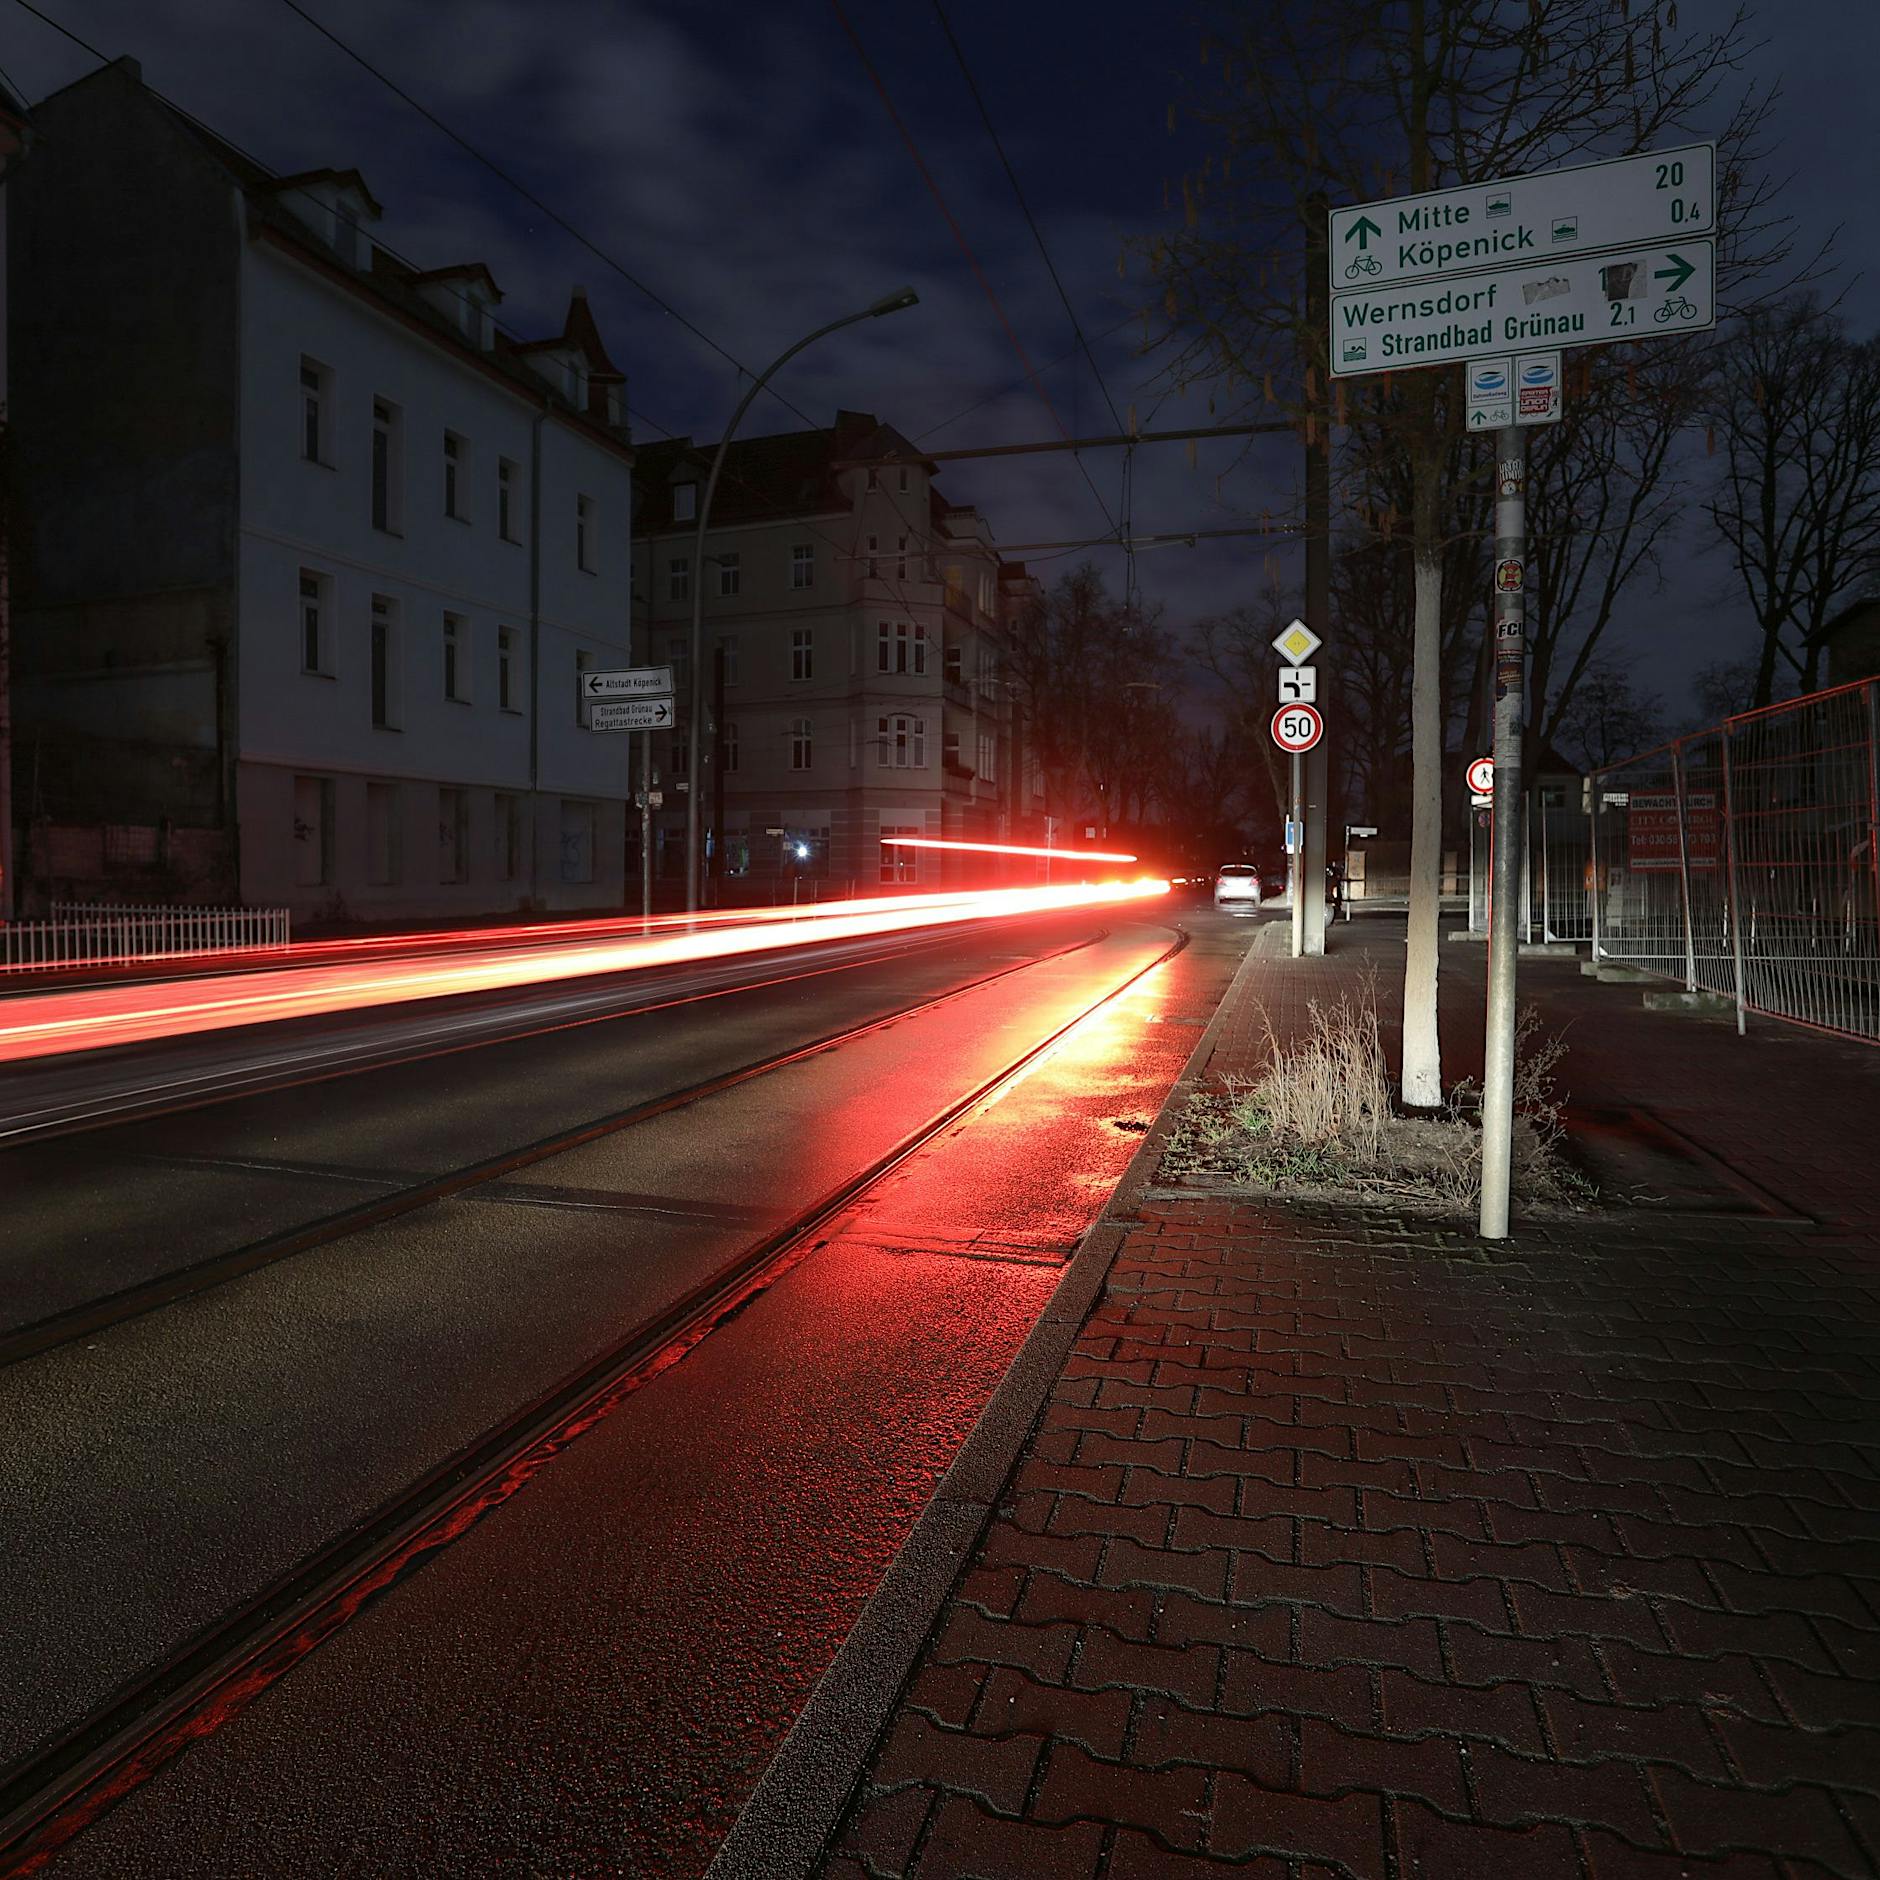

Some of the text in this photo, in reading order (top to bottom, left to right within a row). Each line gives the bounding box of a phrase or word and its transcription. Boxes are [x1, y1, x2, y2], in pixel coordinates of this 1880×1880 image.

[1655, 162, 1684, 190] 20
[1398, 205, 1470, 234] Mitte
[1671, 198, 1700, 223] 0.4
[1398, 226, 1535, 268] Köpenick
[1343, 284, 1498, 327] Wernsdorf
[1610, 302, 1635, 326] 2.1
[1381, 313, 1585, 356] Strandbad Grünau
[606, 678, 661, 689] Altstadt Köpenick
[600, 703, 653, 717] Strandbad Grünau
[594, 716, 653, 730] Regattastrecke
[1284, 716, 1311, 738] 50
